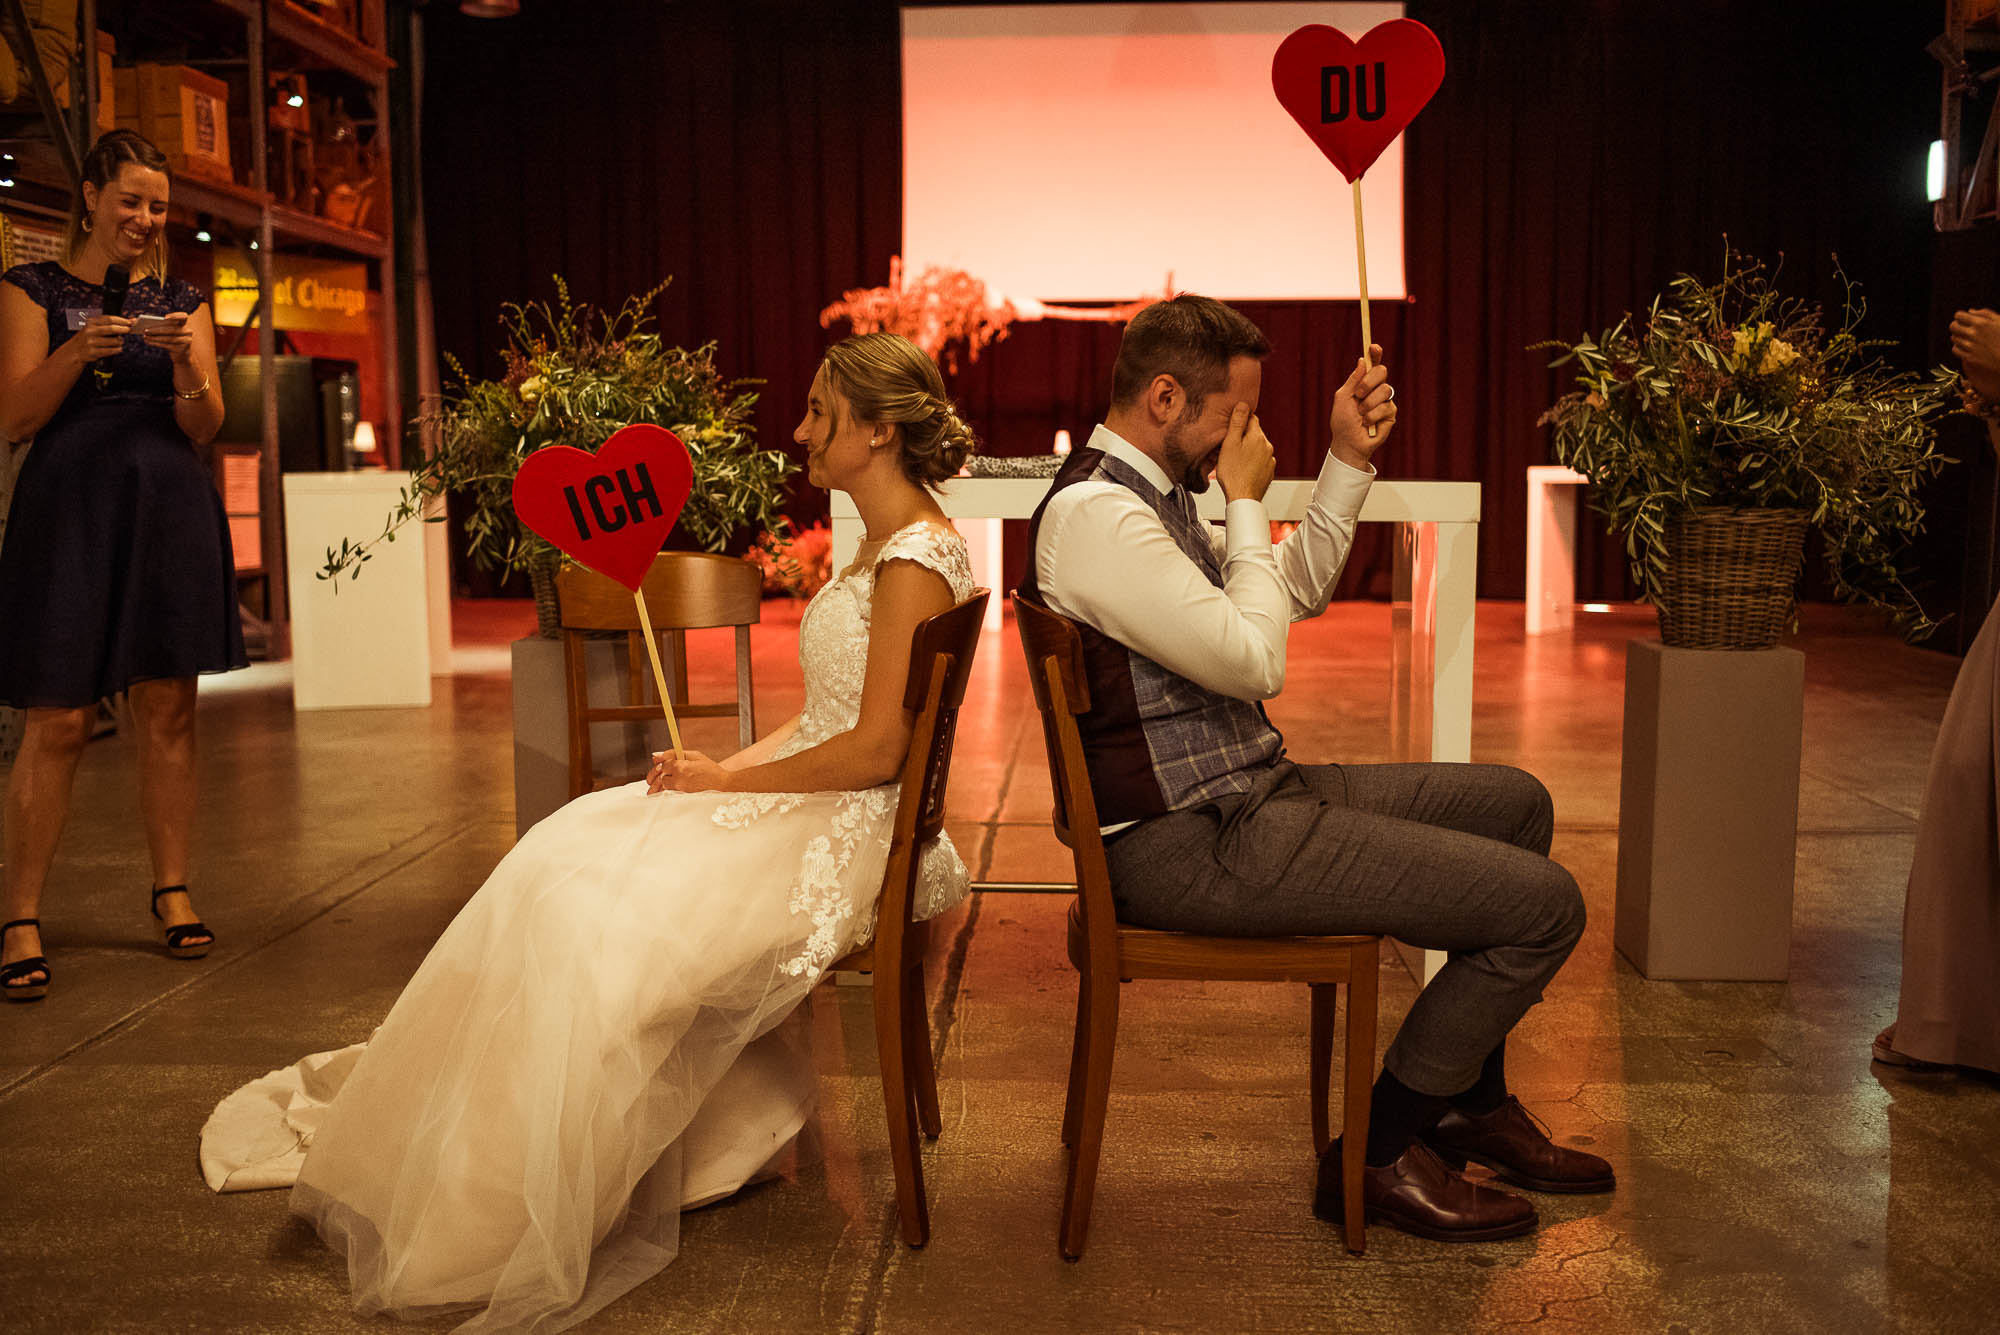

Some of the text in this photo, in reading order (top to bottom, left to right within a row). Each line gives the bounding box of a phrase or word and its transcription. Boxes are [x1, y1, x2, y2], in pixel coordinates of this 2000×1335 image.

[1320, 62, 1386, 124] DU
[297, 277, 366, 317] Chicago
[563, 462, 664, 541] ICH
